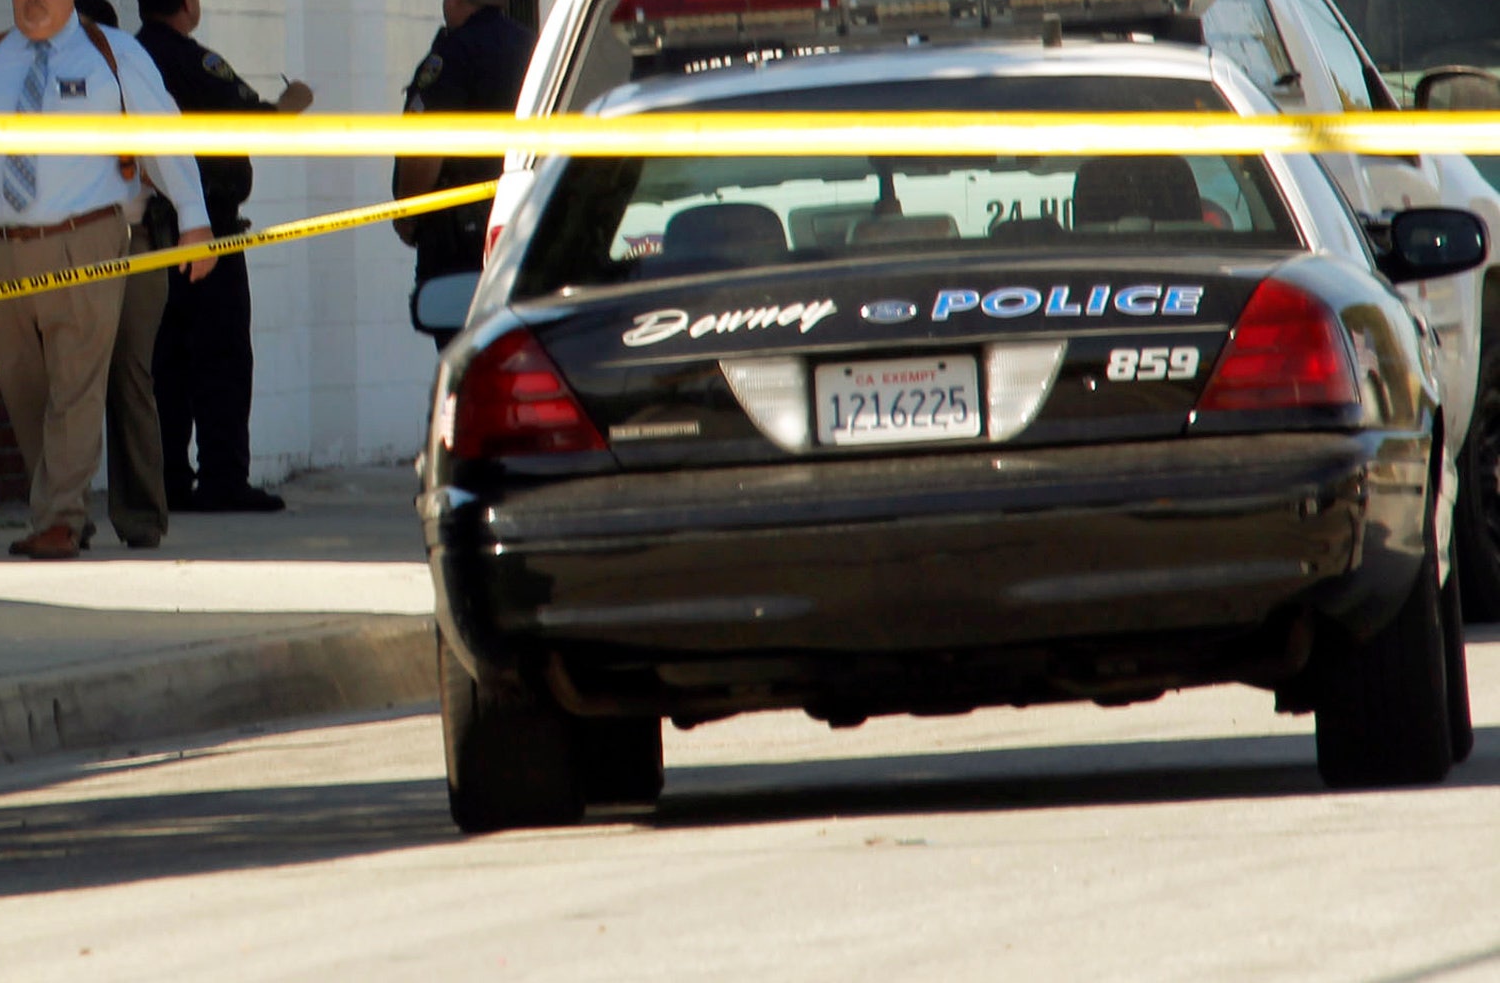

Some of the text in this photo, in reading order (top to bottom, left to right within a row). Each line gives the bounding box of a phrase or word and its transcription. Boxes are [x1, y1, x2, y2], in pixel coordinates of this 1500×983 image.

[931, 284, 1204, 321] POLICE
[882, 368, 938, 386] EXEMPT
[1107, 346, 1200, 382] 859
[829, 385, 969, 432] 1216225
